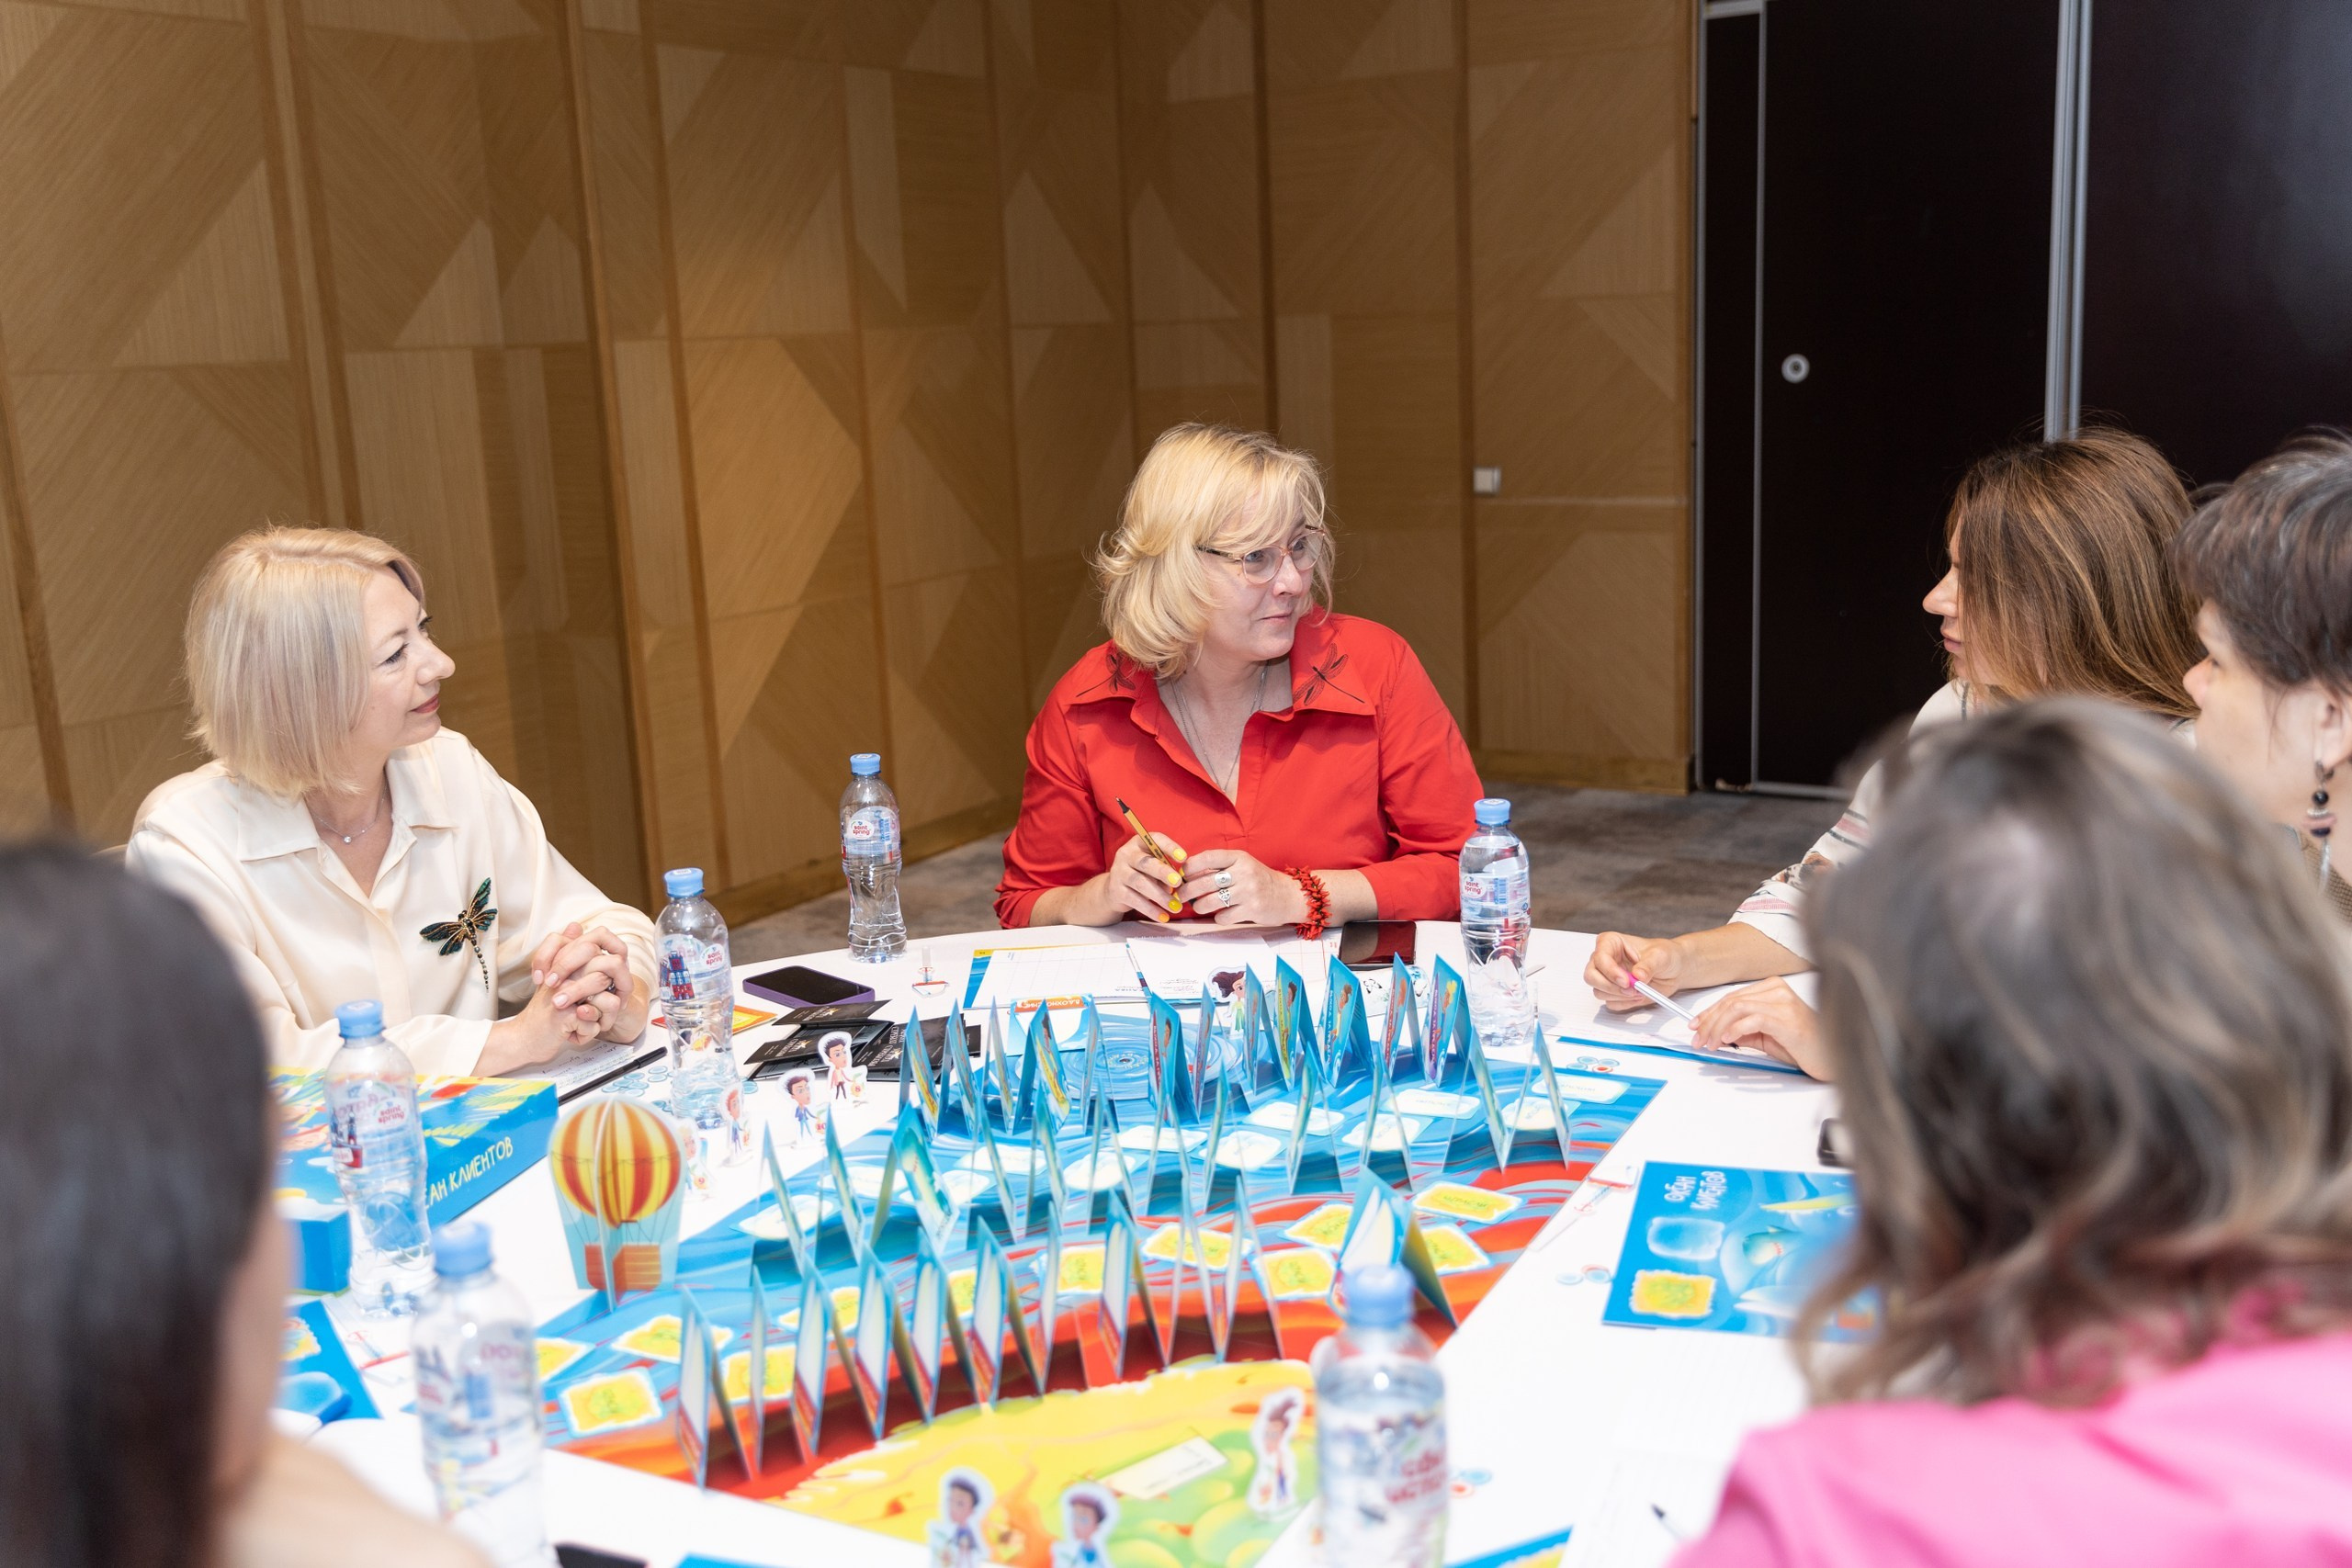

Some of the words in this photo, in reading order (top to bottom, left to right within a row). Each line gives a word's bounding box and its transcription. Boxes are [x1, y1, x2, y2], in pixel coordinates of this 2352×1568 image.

[1464, 886, 1482, 895] spring
[378, 1111, 405, 1124] spring
[448, 1136, 514, 1191] КЛИЕНТОВ
[1690, 1170, 1726, 1210] КЛИЕНТОВ
